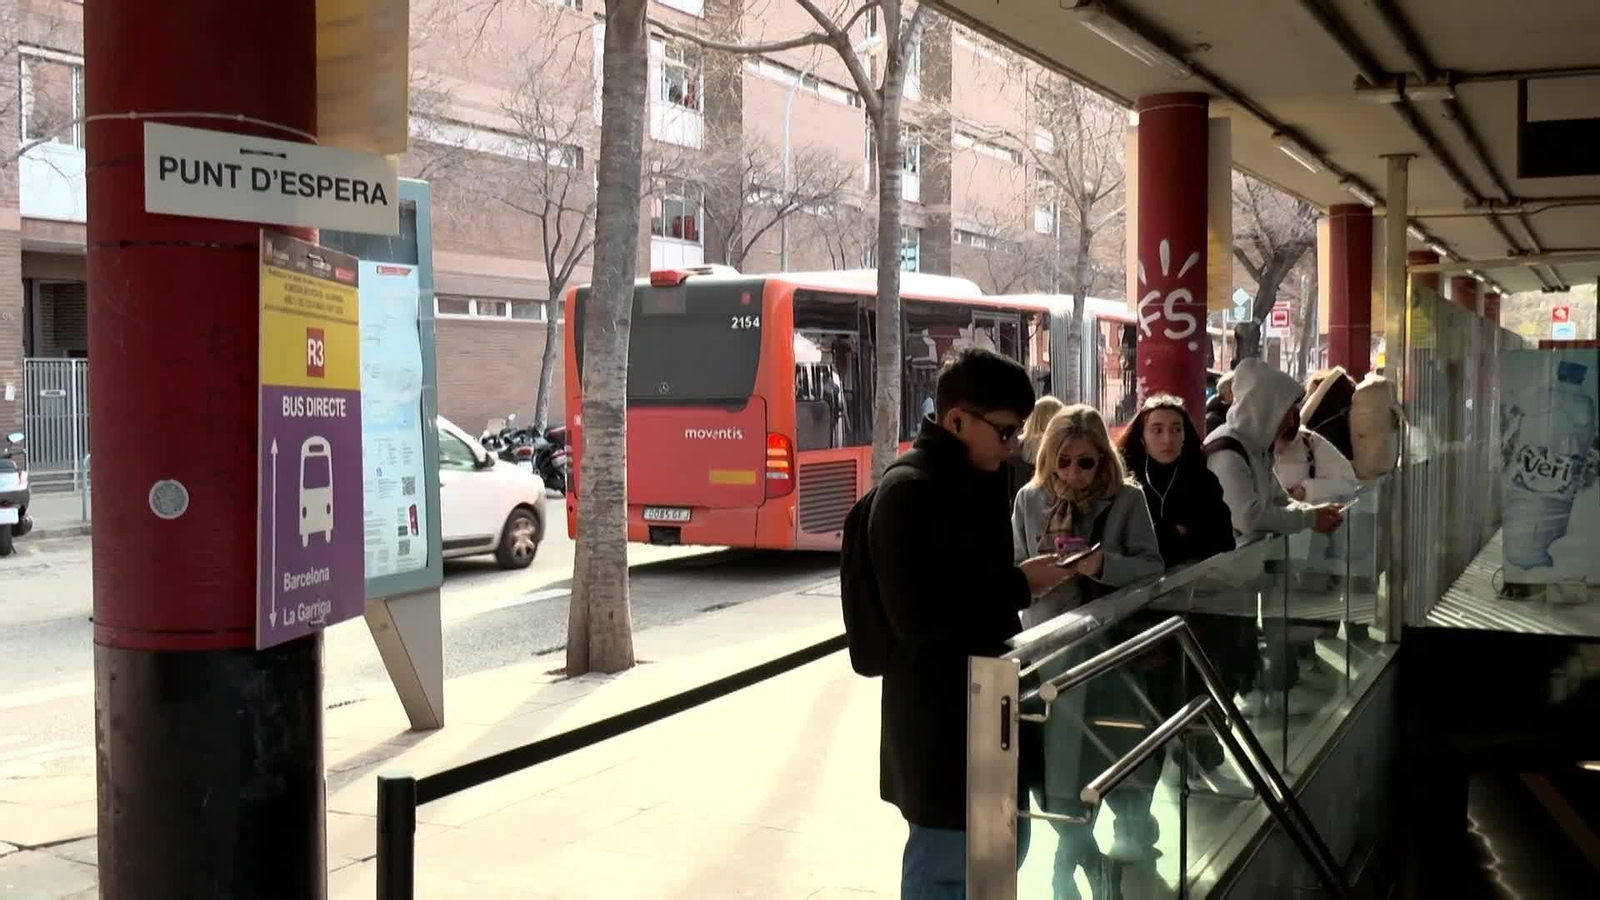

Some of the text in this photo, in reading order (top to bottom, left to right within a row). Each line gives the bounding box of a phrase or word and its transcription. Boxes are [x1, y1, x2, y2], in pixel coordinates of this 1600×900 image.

[158, 155, 388, 206] PUNT D'ESPERA
[731, 315, 760, 329] 2154
[307, 338, 324, 367] R3
[282, 395, 347, 417] BUS DIRECTE
[684, 426, 744, 440] moventis
[1524, 455, 1570, 481] Veri
[283, 567, 330, 592] Barcelona
[283, 599, 332, 626] La Garriga
